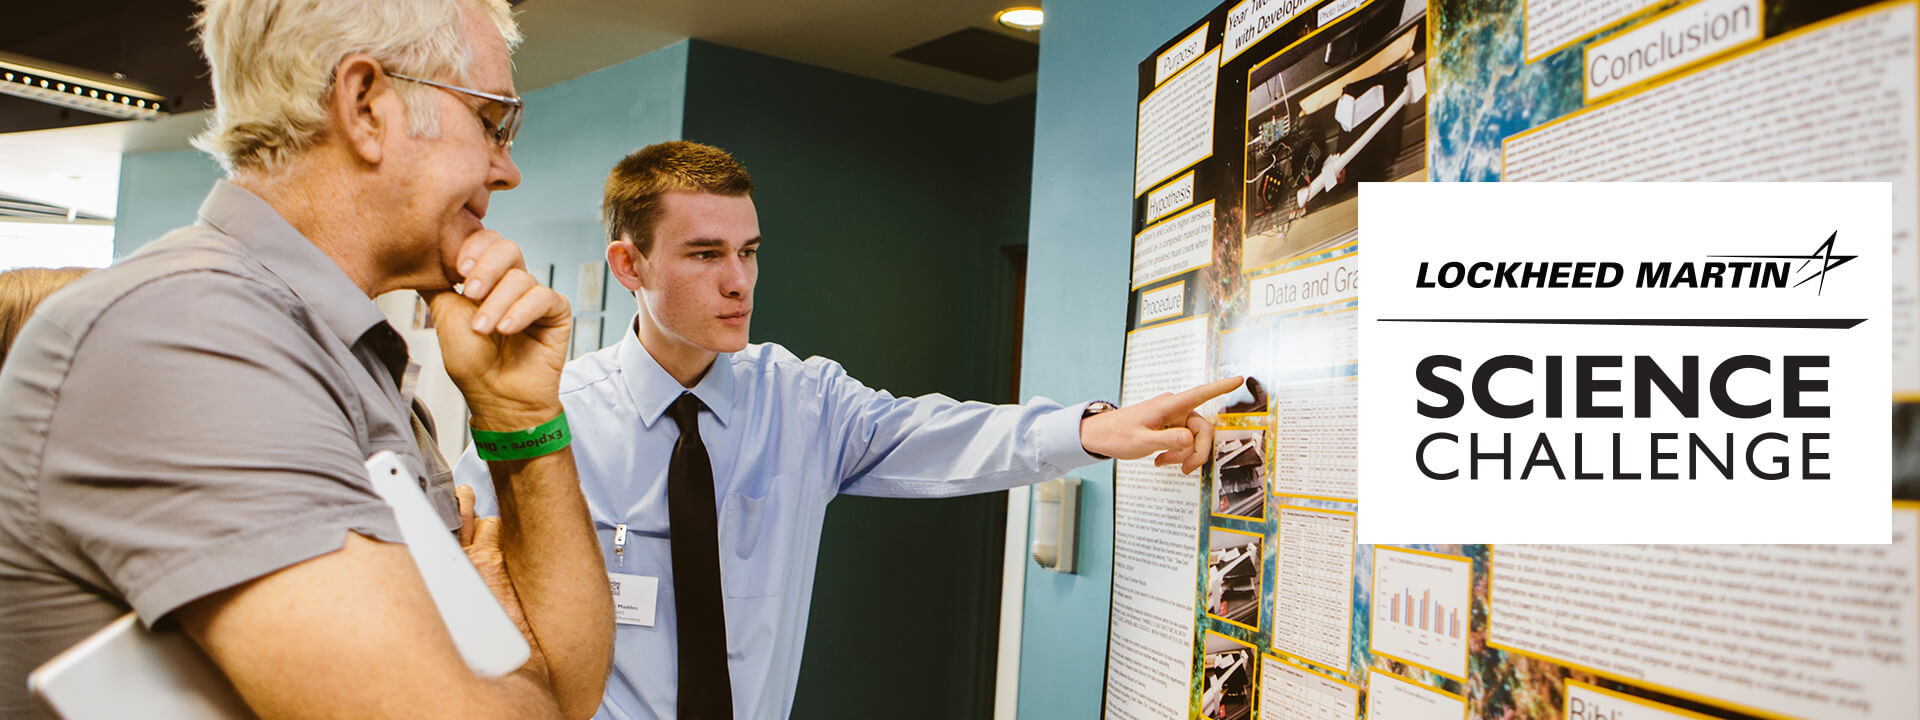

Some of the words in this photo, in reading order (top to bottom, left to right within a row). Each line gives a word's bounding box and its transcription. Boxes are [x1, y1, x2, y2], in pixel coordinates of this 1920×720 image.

[1229, 7, 1248, 31] Year
[1235, 24, 1255, 49] with
[1590, 4, 1751, 87] Conclusion
[1163, 41, 1198, 75] Purpose
[1150, 183, 1191, 219] Hypothesis
[1143, 292, 1182, 315] Procedure
[1265, 283, 1297, 307] Data
[1302, 272, 1329, 300] and
[511, 429, 563, 451] Explore
